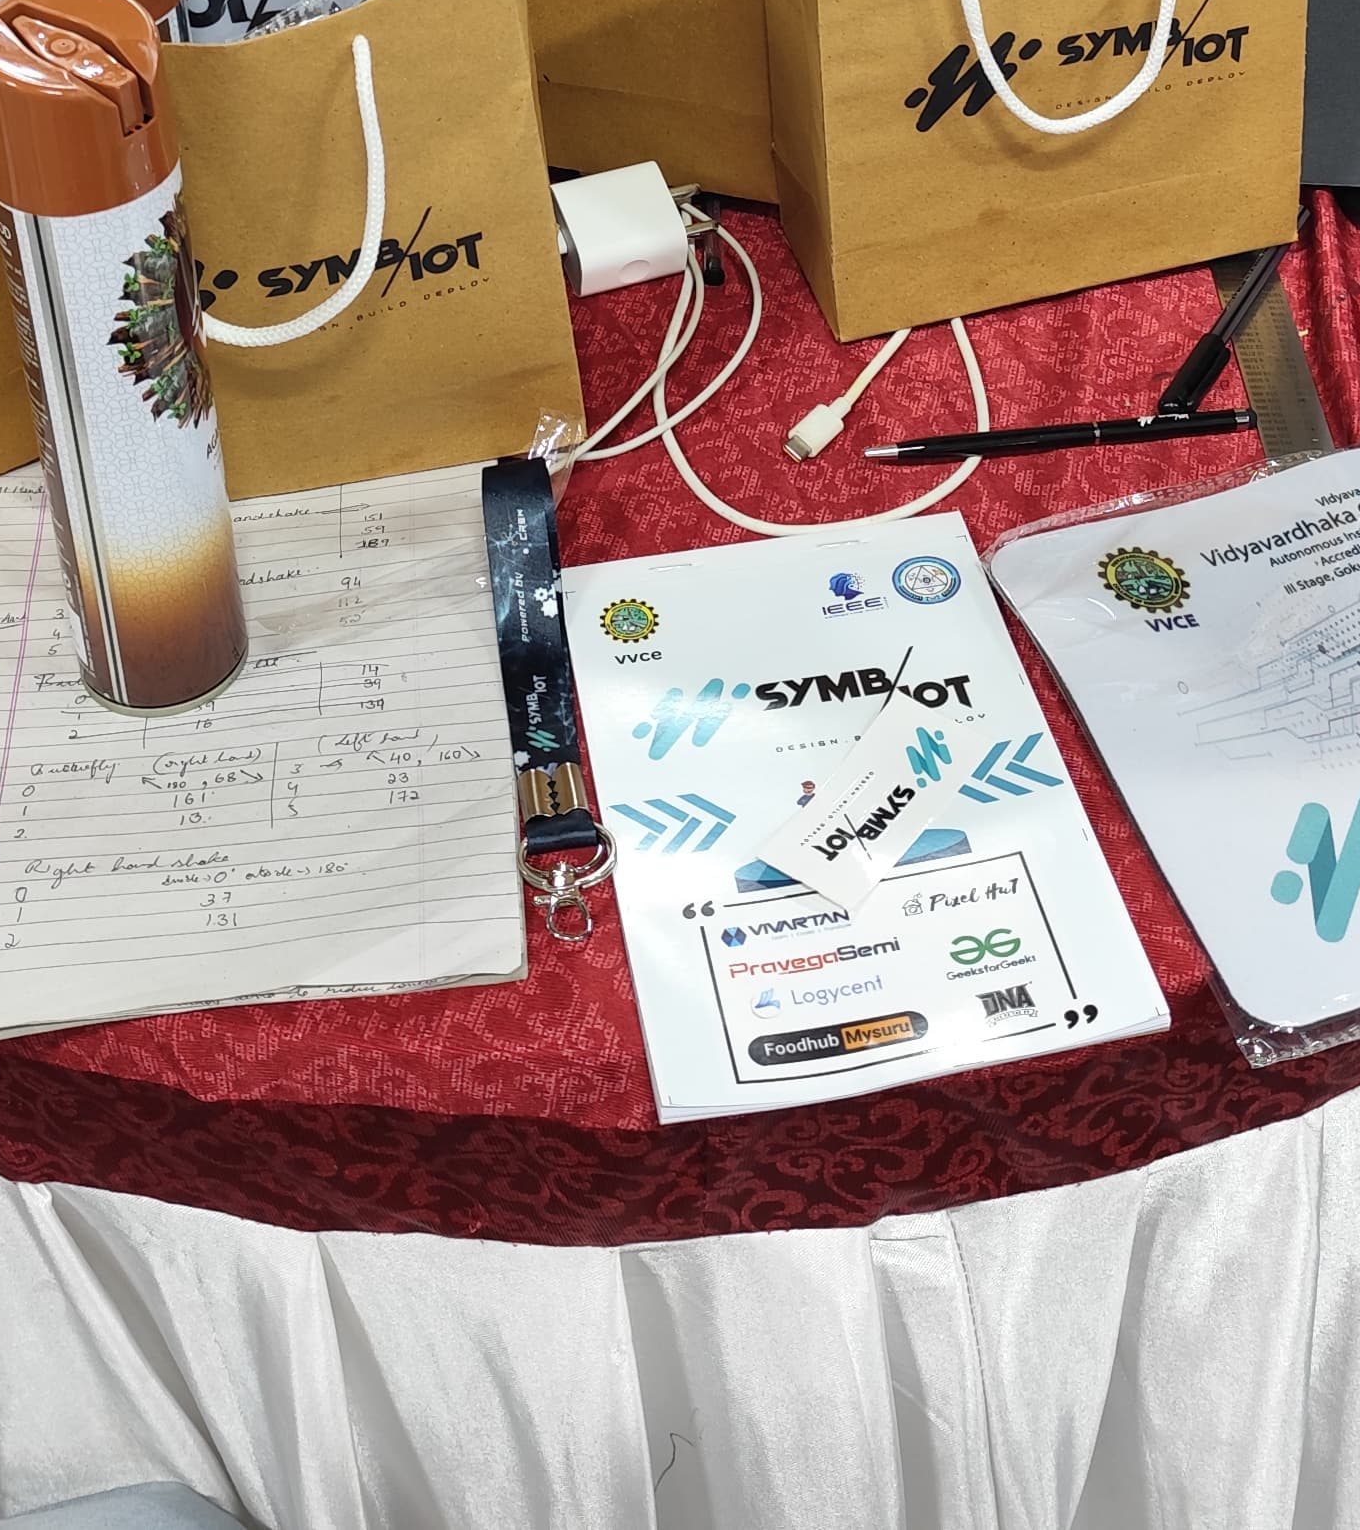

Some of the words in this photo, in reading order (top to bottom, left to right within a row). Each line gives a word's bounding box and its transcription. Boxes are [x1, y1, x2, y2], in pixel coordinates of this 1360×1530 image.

[1200, 509, 1359, 568] Vidyavardhaka
[1269, 537, 1343, 568] Autonomous
[340, 577, 362, 590] 94
[1283, 584, 1297, 595] III
[1297, 572, 1334, 593] Stage,
[822, 597, 883, 616] IEEE
[1144, 614, 1200, 633] VVCE
[388, 772, 409, 784] 23
[389, 790, 421, 802] 172
[200, 892, 233, 907] 37
[929, 888, 980, 912] Pixel
[748, 909, 850, 936] VIVARTAN
[729, 937, 901, 979] PravegaSemi
[791, 976, 884, 1006] Logycent
[975, 983, 1036, 1018] DNA
[764, 1024, 840, 1057] Foodhub
[845, 1019, 911, 1051] Mysuru
